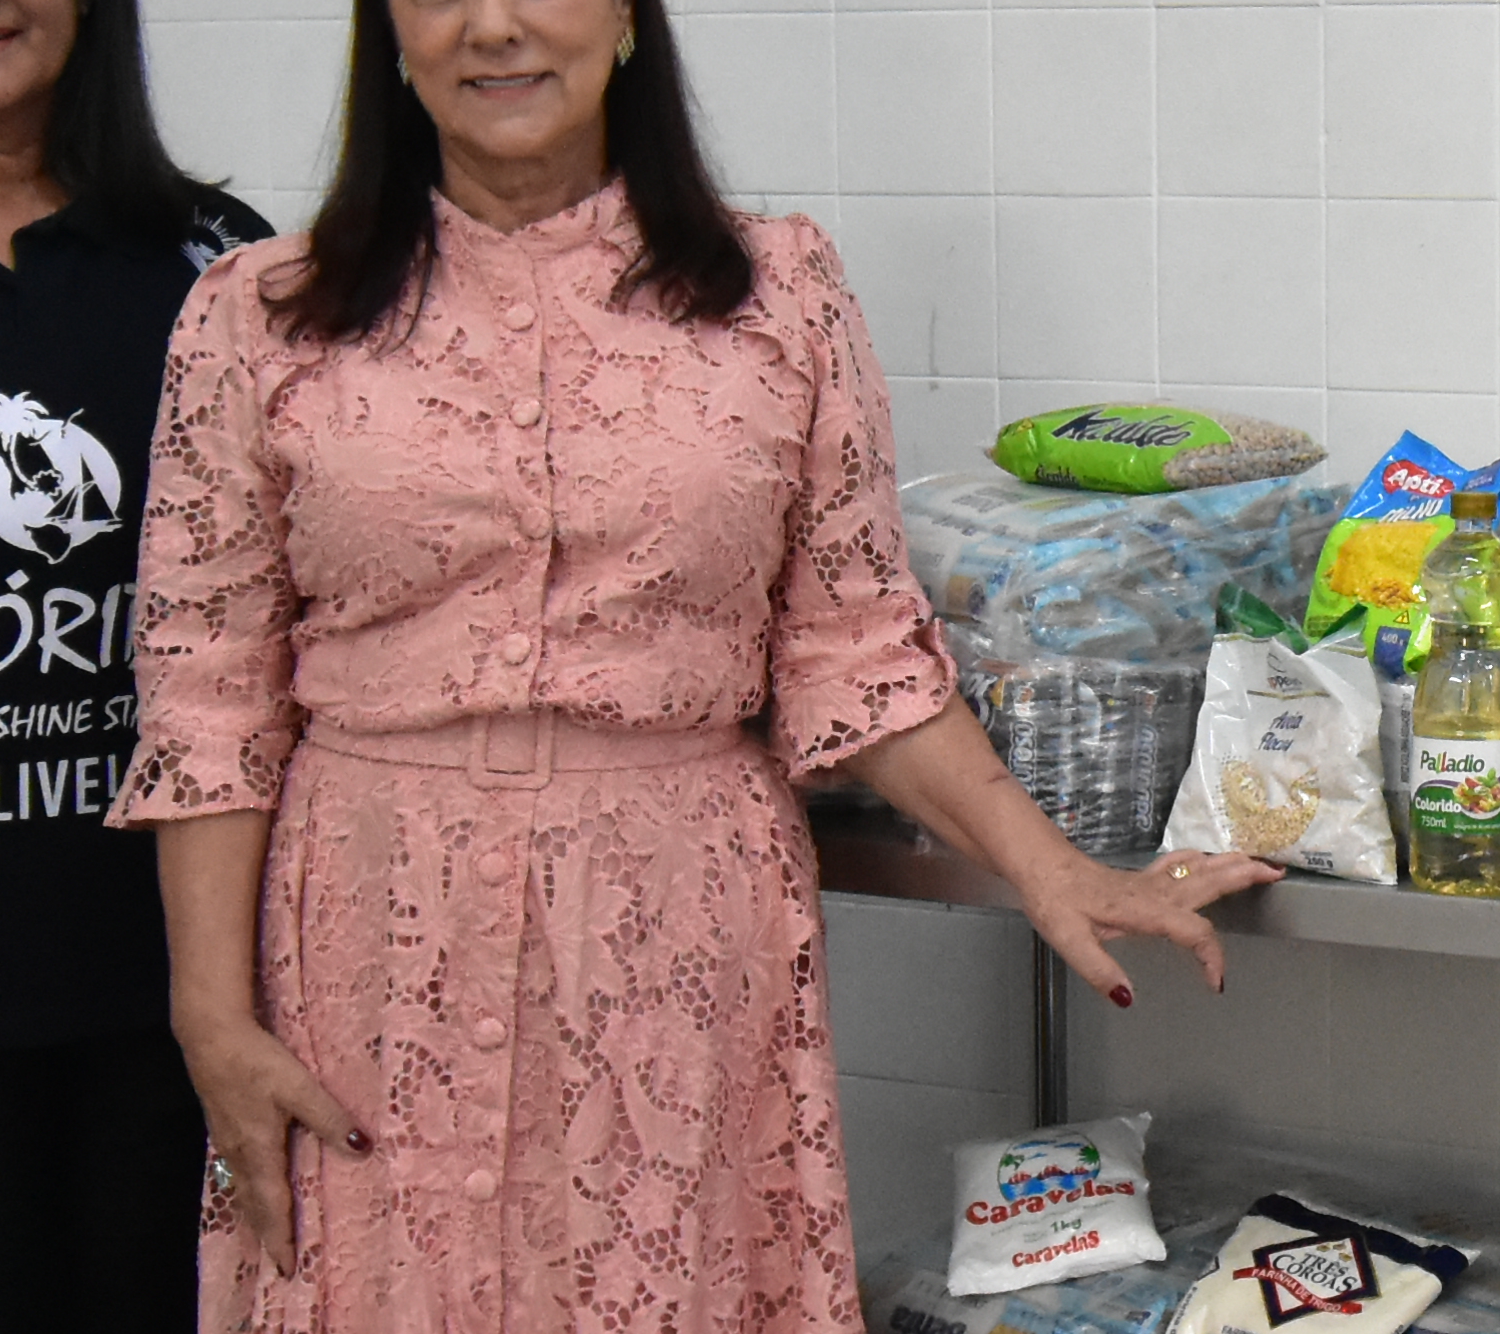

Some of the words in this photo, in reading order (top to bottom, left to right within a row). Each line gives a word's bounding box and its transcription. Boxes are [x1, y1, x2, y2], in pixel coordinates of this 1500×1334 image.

[1387, 467, 1444, 495] Apti
[1420, 750, 1485, 773] Palladio
[1415, 796, 1462, 813] Colorido
[965, 1179, 1136, 1225] Caravelas
[1272, 1253, 1359, 1294] COROAS
[1302, 1252, 1349, 1278] TRÊS
[1251, 1267, 1299, 1295] FARINHA
[1295, 1284, 1312, 1302] DE
[1308, 1296, 1343, 1313] TRIGO
